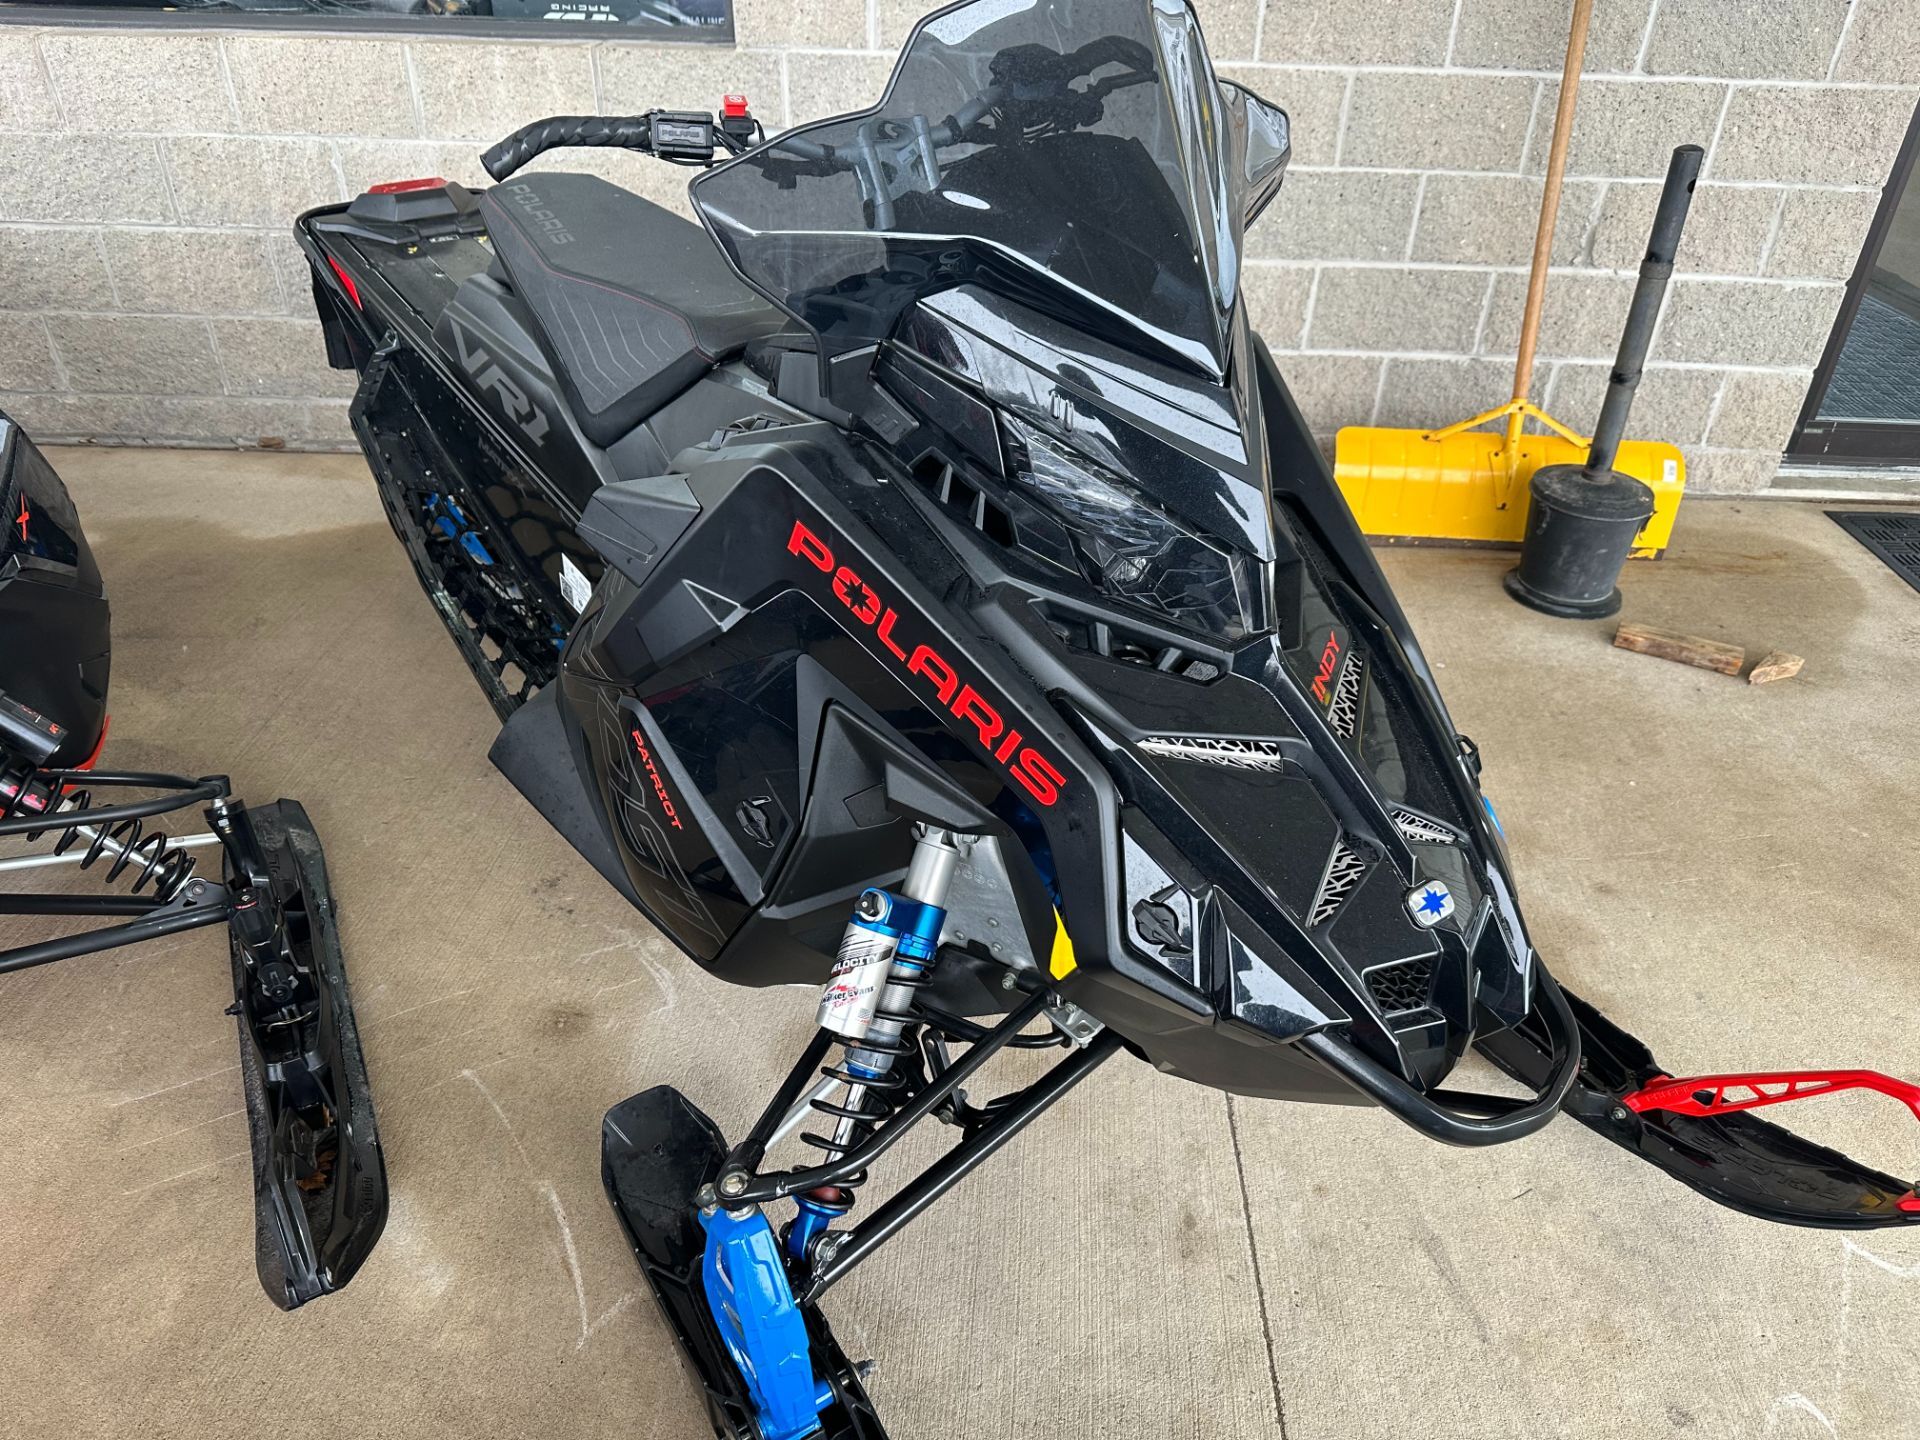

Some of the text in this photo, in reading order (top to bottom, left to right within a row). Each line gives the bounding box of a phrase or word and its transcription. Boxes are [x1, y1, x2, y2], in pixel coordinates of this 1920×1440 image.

[550, 3, 610, 12] RACING
[661, 128, 700, 138] POLARIS
[506, 184, 576, 245] POLARIS
[450, 318, 550, 447] VR1
[787, 520, 1067, 806] POLARIS
[1311, 630, 1340, 702] INDY
[632, 730, 683, 831] PATRIOT
